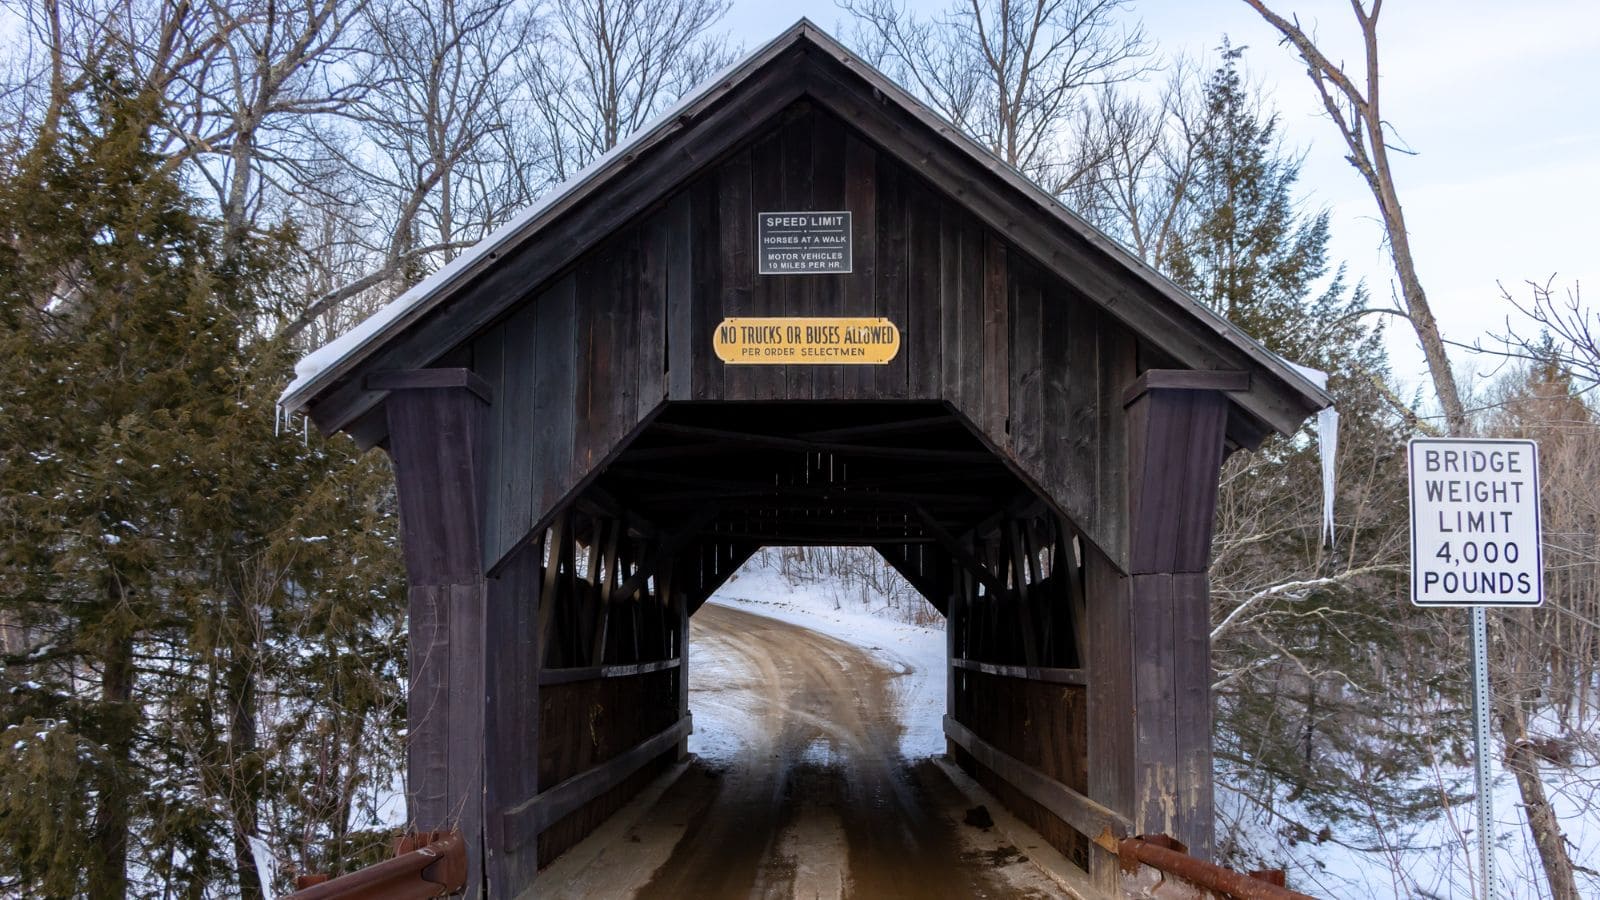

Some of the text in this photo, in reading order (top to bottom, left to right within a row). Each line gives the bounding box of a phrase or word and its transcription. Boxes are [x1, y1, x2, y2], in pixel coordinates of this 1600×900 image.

[767, 216, 843, 227] SPEED LIMIT
[764, 236, 798, 244] HORSES
[801, 252, 843, 260] VEHICLES
[721, 325, 894, 344] NO TRUCKS OR BUSES ALLOWED
[742, 348, 865, 356] PER ORDER SELECTMEN
[1425, 450, 1522, 473] BRIDGE
[1425, 480, 1523, 503] WEIGHT
[1439, 511, 1512, 533] LIMIT
[1436, 541, 1519, 566] 4,000
[1424, 572, 1531, 594] POUNDS
